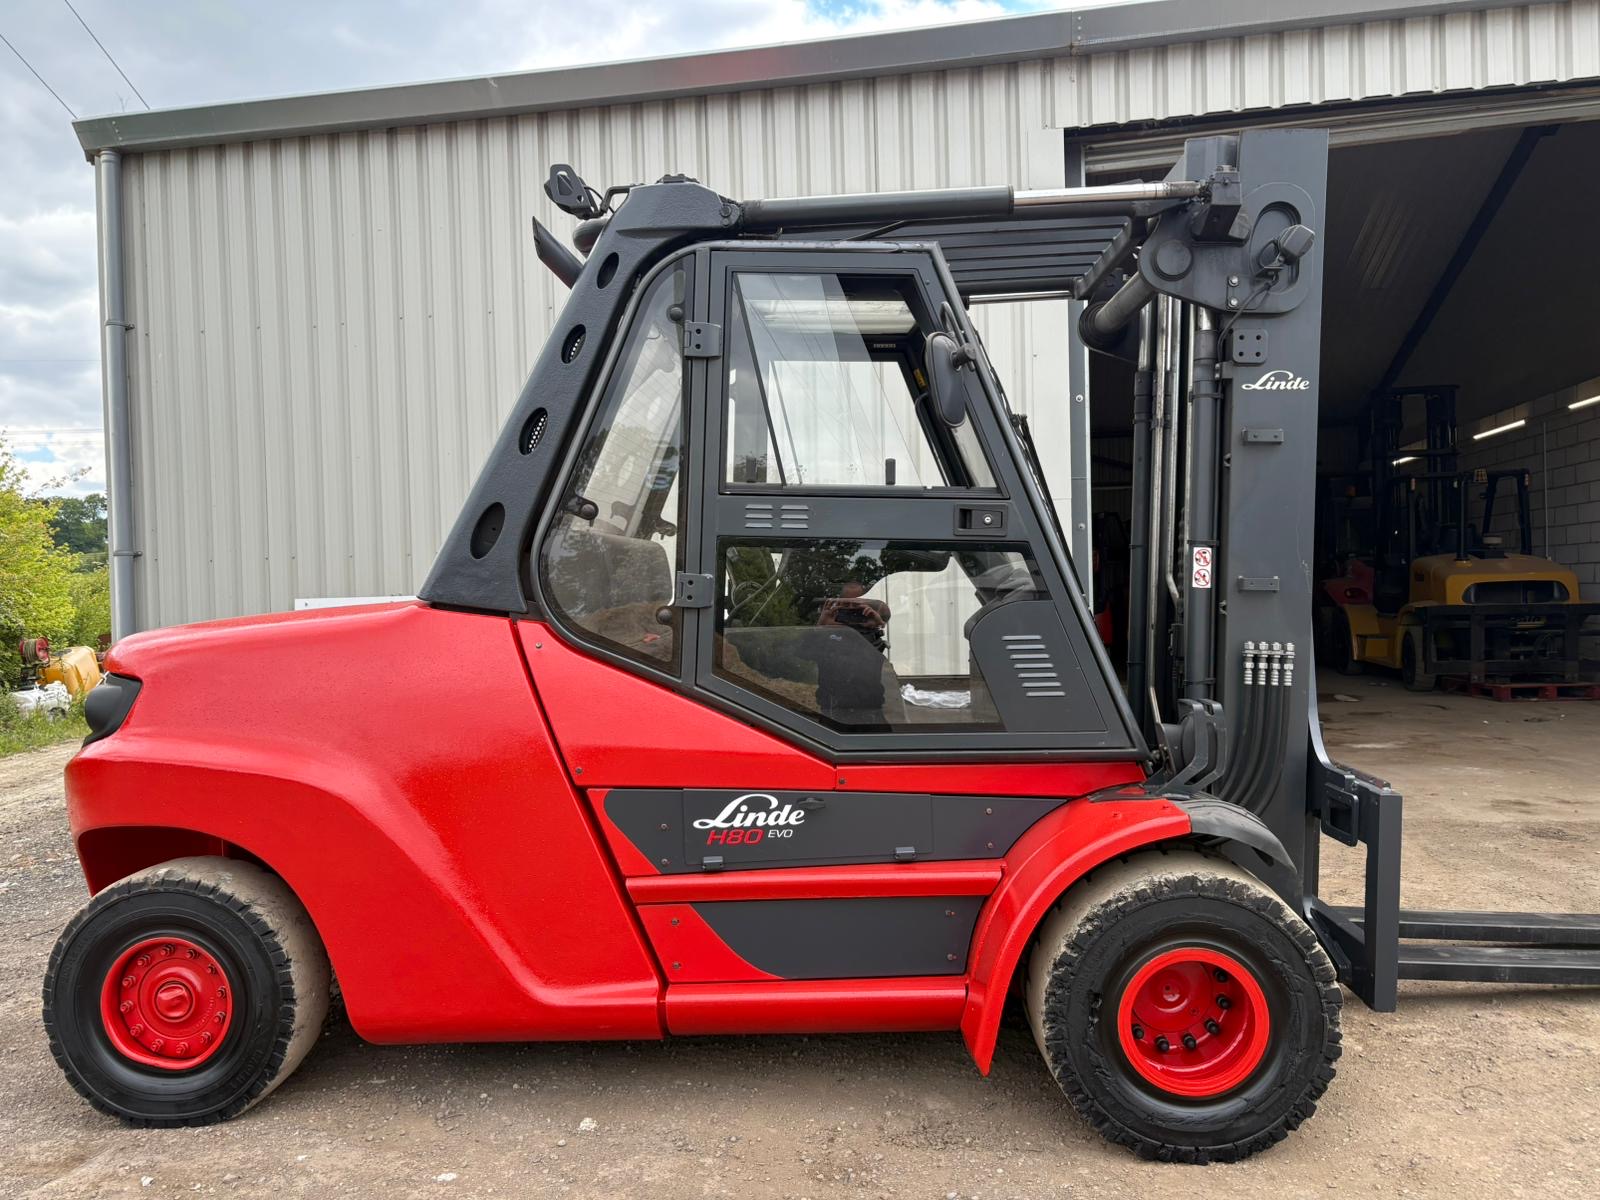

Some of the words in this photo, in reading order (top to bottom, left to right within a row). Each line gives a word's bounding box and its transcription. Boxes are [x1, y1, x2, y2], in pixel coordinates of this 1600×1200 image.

[1241, 370, 1310, 390] Linde
[693, 793, 805, 829] Linde
[706, 828, 765, 846] H80
[767, 829, 794, 838] EVO
